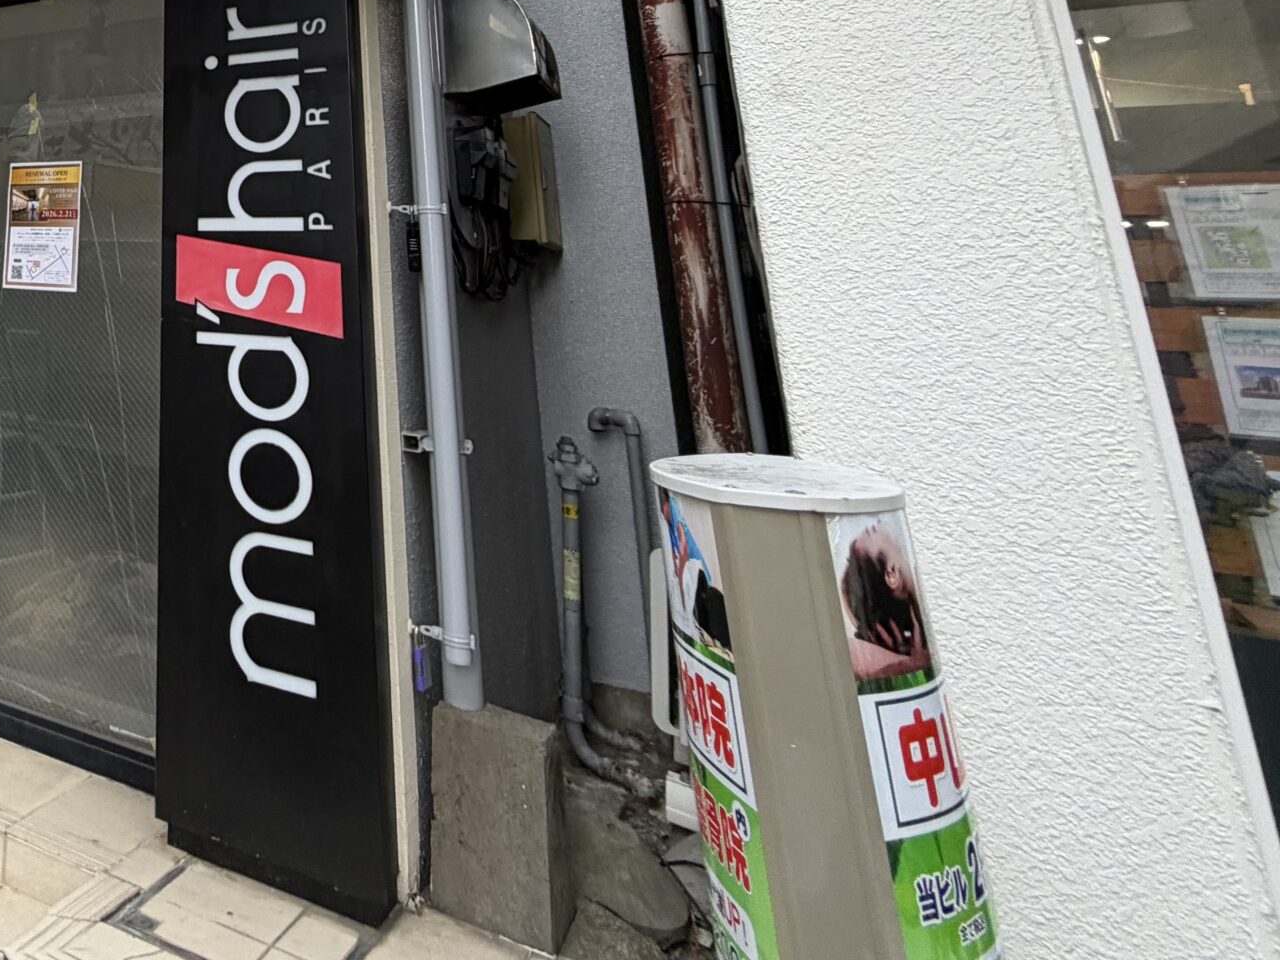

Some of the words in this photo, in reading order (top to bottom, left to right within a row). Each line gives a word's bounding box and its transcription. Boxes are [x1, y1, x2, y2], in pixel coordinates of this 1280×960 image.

[52, 169, 69, 177] OPEN
[197, 6, 305, 233] hair
[303, 16, 334, 232] PARIS
[196, 259, 319, 700] mod's
